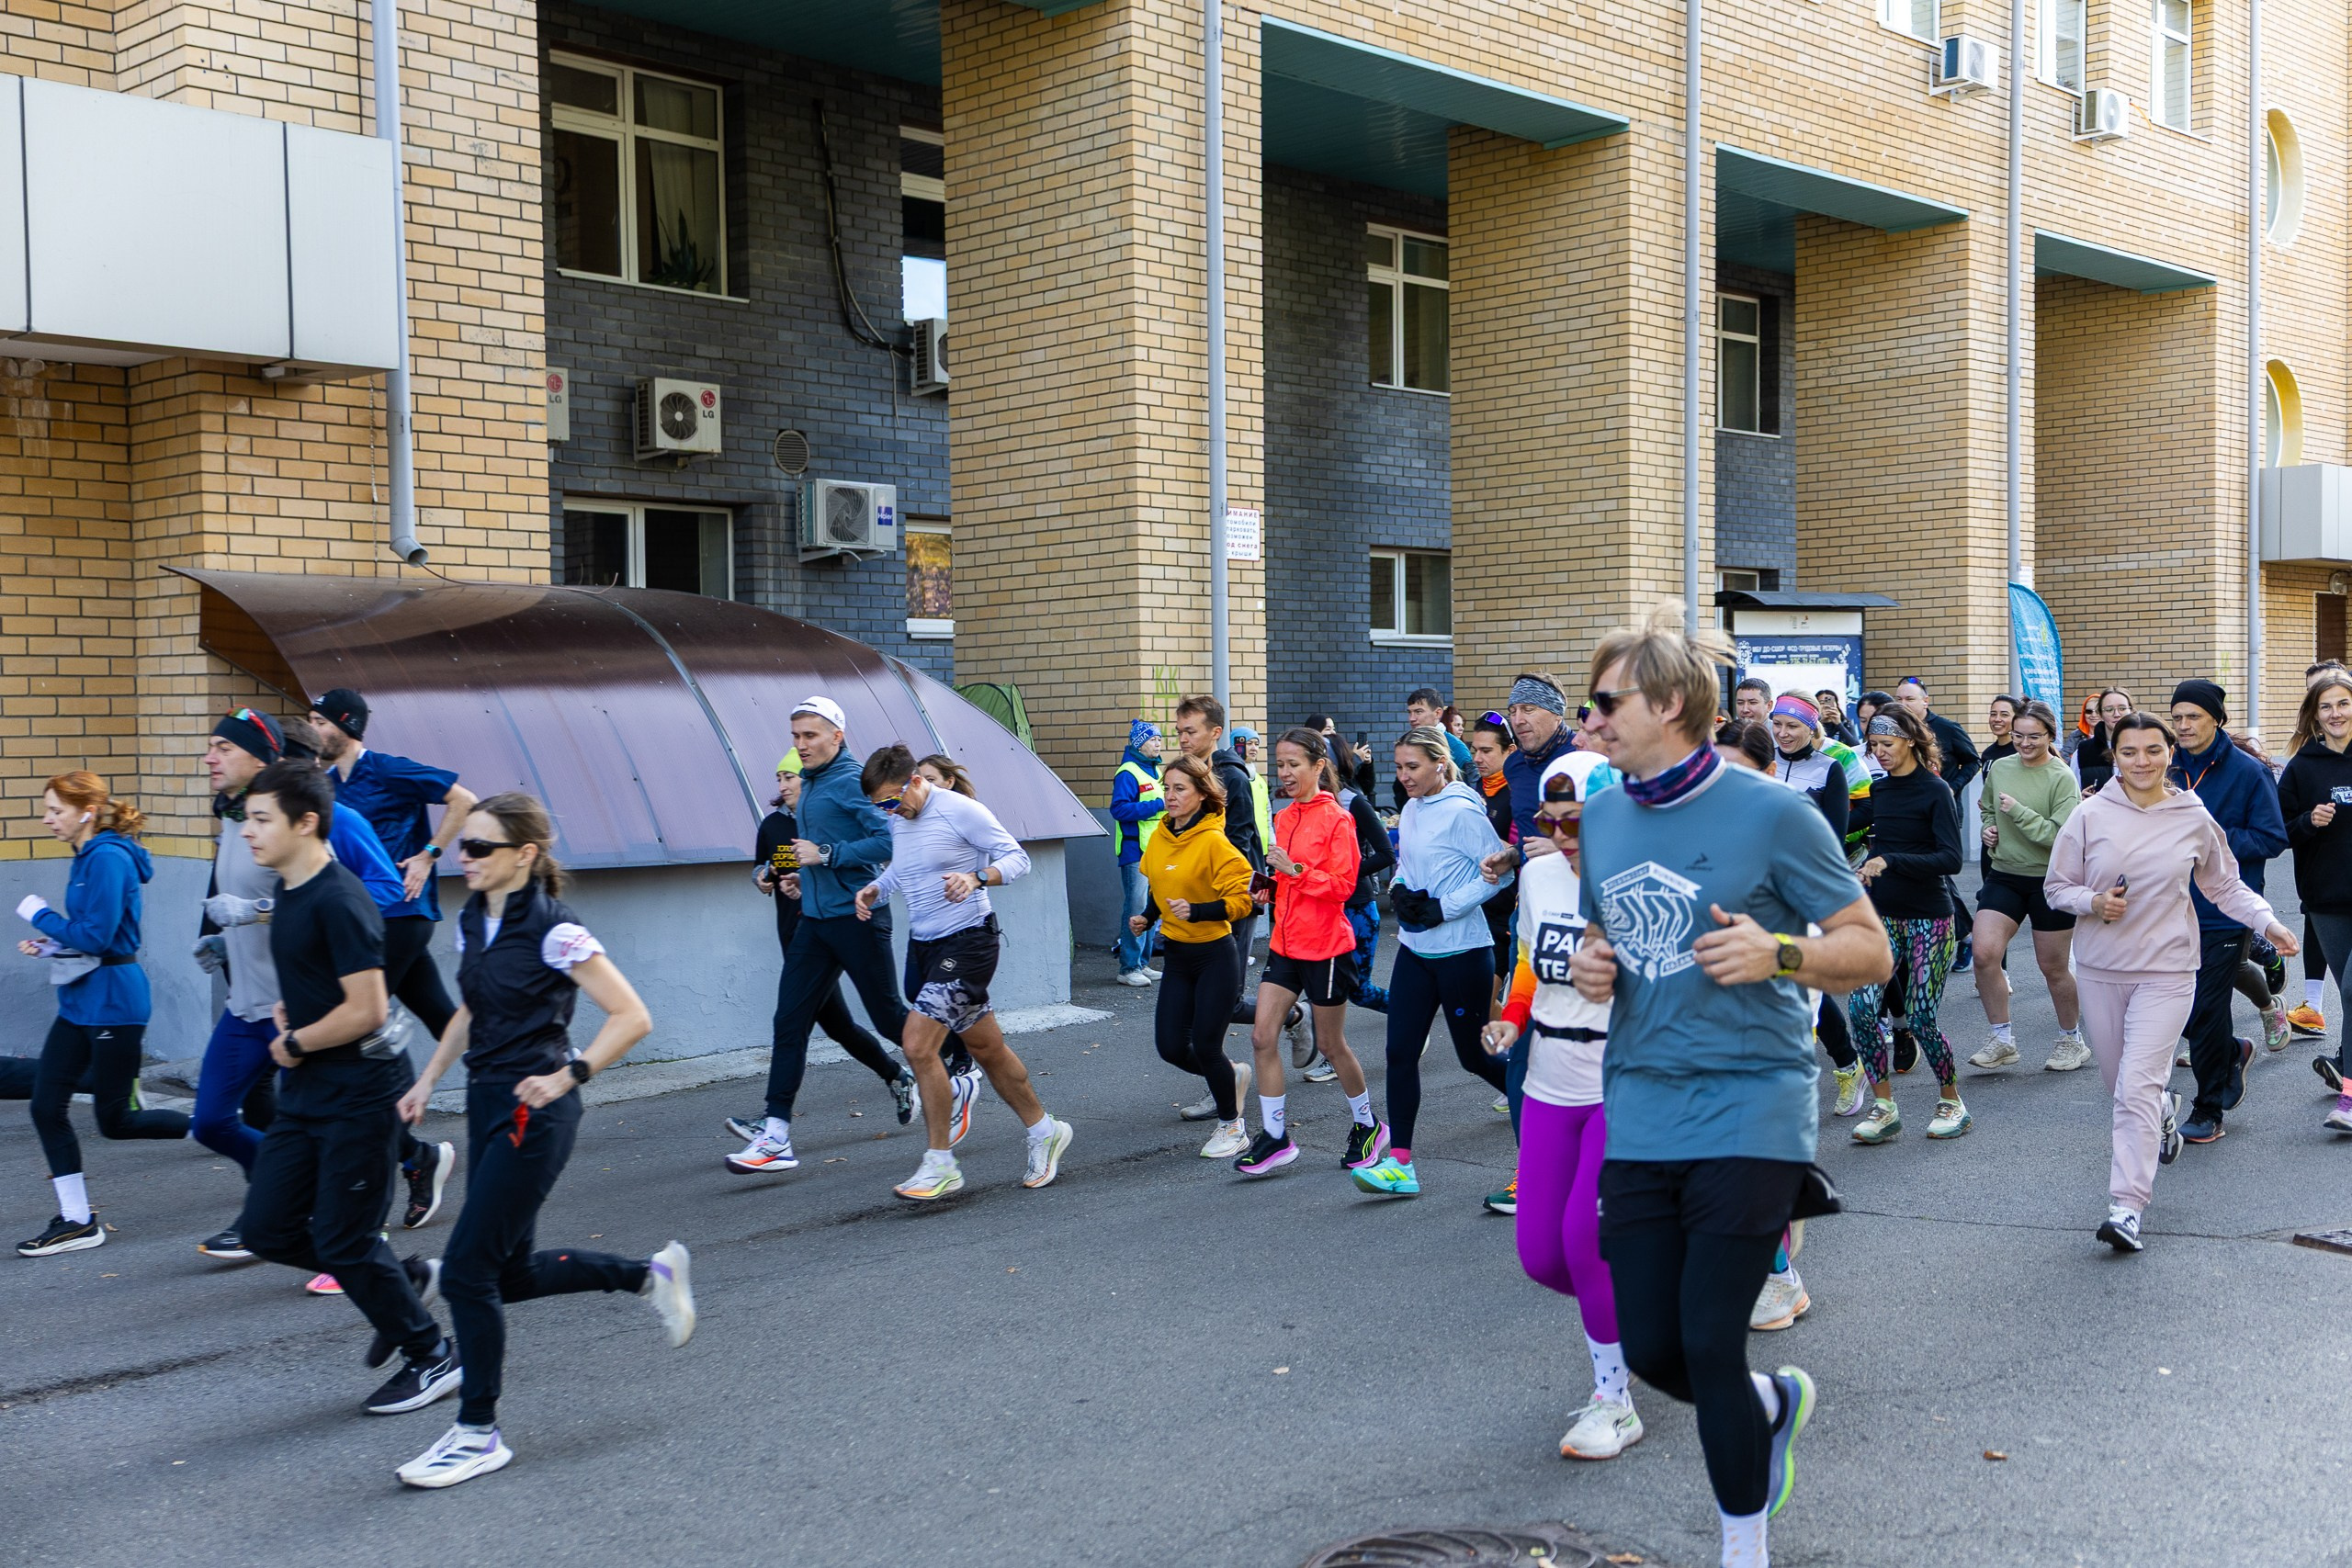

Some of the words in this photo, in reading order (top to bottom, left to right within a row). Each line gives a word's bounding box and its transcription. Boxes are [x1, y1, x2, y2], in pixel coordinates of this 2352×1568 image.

[548, 395, 562, 404] LG
[702, 410, 715, 419] LG
[1133, 732, 1149, 749] SSIA
[772, 852, 797, 861] СПОРТИ
